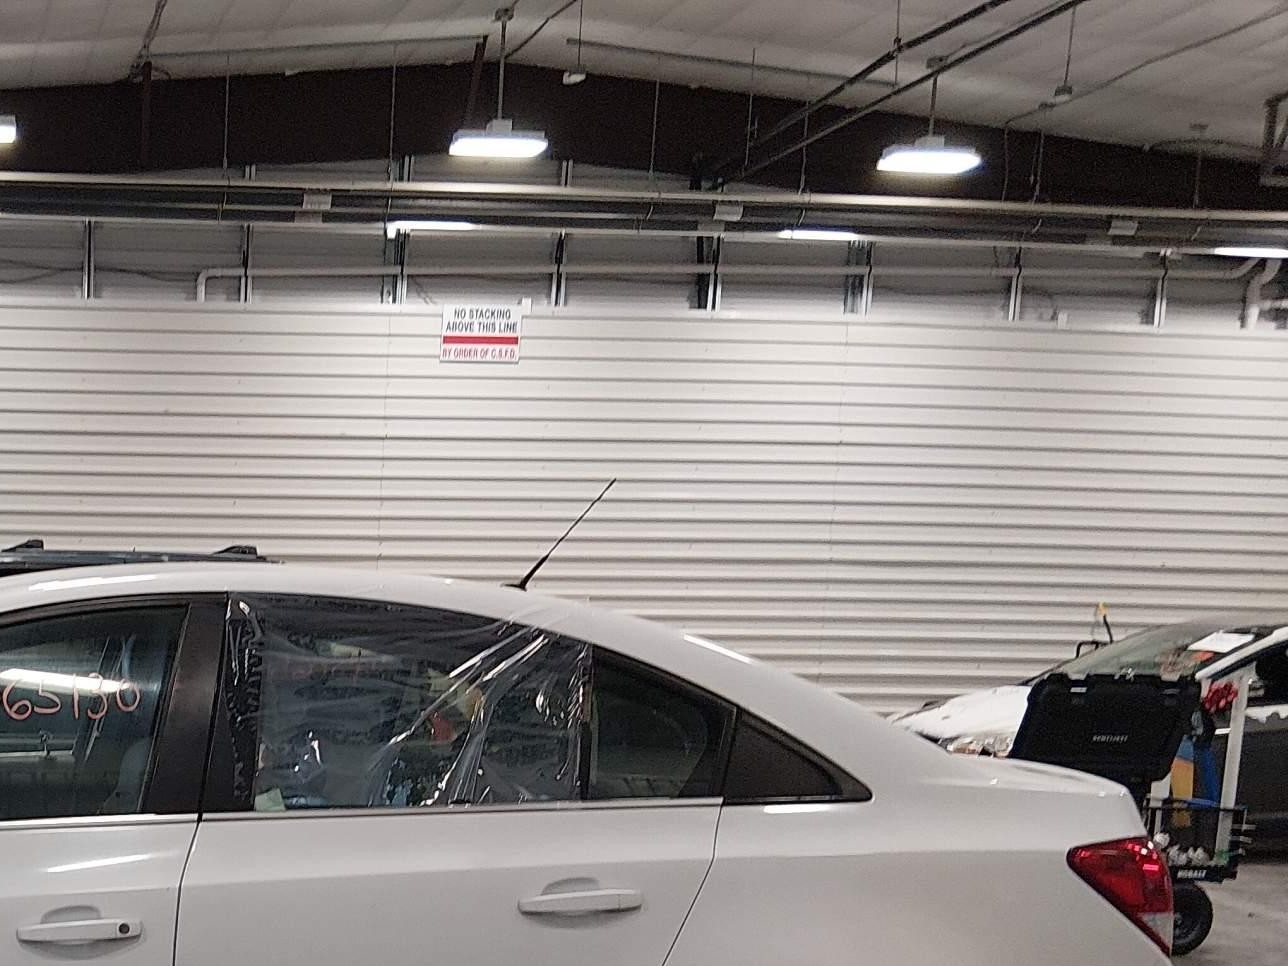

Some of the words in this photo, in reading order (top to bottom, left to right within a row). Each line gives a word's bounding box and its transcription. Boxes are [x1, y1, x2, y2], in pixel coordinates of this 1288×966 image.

[454, 308, 466, 320] NO
[469, 308, 511, 320] STACKING
[446, 321, 474, 333] ABOVE
[478, 321, 496, 333] THIS
[499, 321, 517, 333] LINE
[442, 347, 452, 358] BY
[454, 347, 478, 358] ORDER
[480, 348, 489, 359] OF
